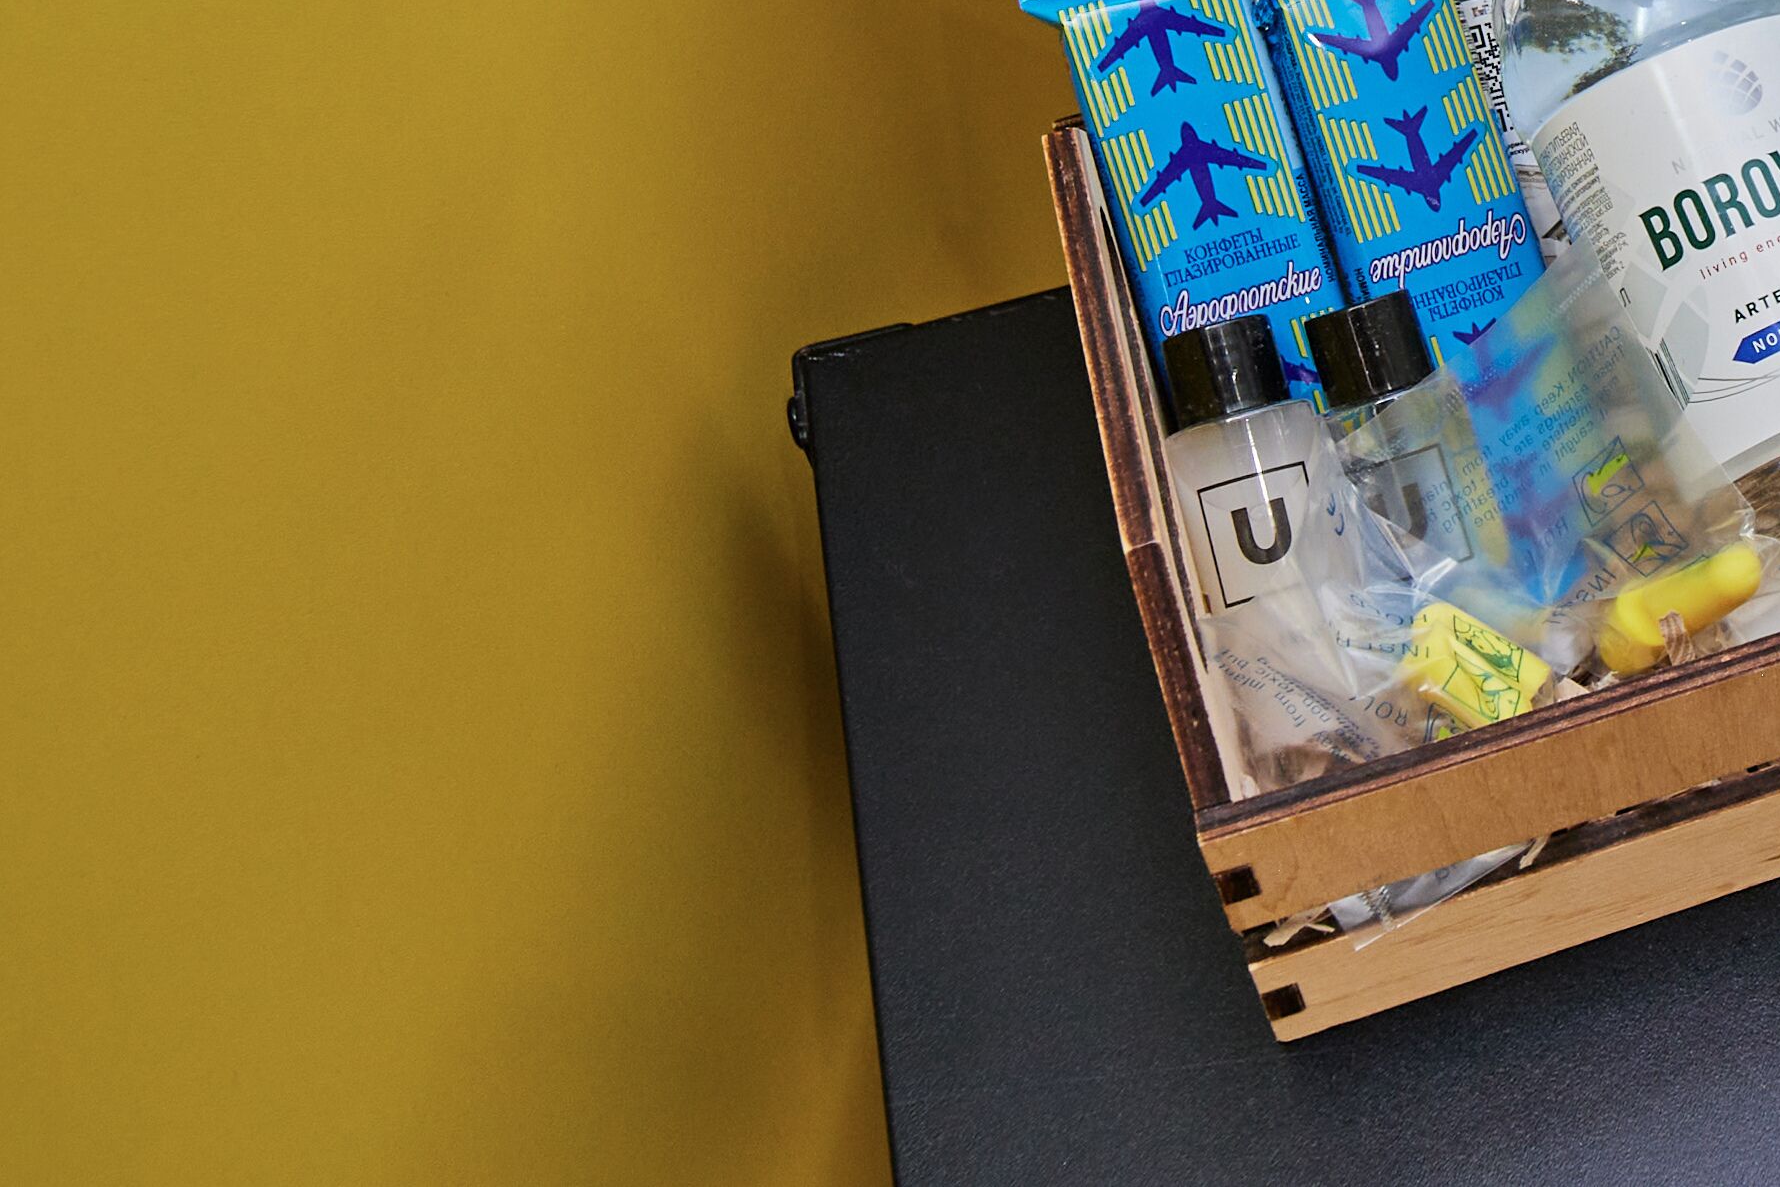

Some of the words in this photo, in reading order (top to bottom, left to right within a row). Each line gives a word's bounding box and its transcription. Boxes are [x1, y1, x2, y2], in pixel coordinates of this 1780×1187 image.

[1296, 173, 1312, 208] МАССА
[1164, 233, 1300, 288] ГЛАЗИРОВАННЫЕ
[1184, 228, 1264, 264] КОНФЕТЫ
[1369, 208, 1527, 289] Аэрофлотские
[1700, 251, 1748, 280] living
[1160, 260, 1321, 337] Аэрофлотские
[1413, 262, 1523, 310] ГЛАЗИРОВАНН
[1428, 285, 1505, 322] КОНФЕТЫ
[1231, 498, 1292, 565] U
